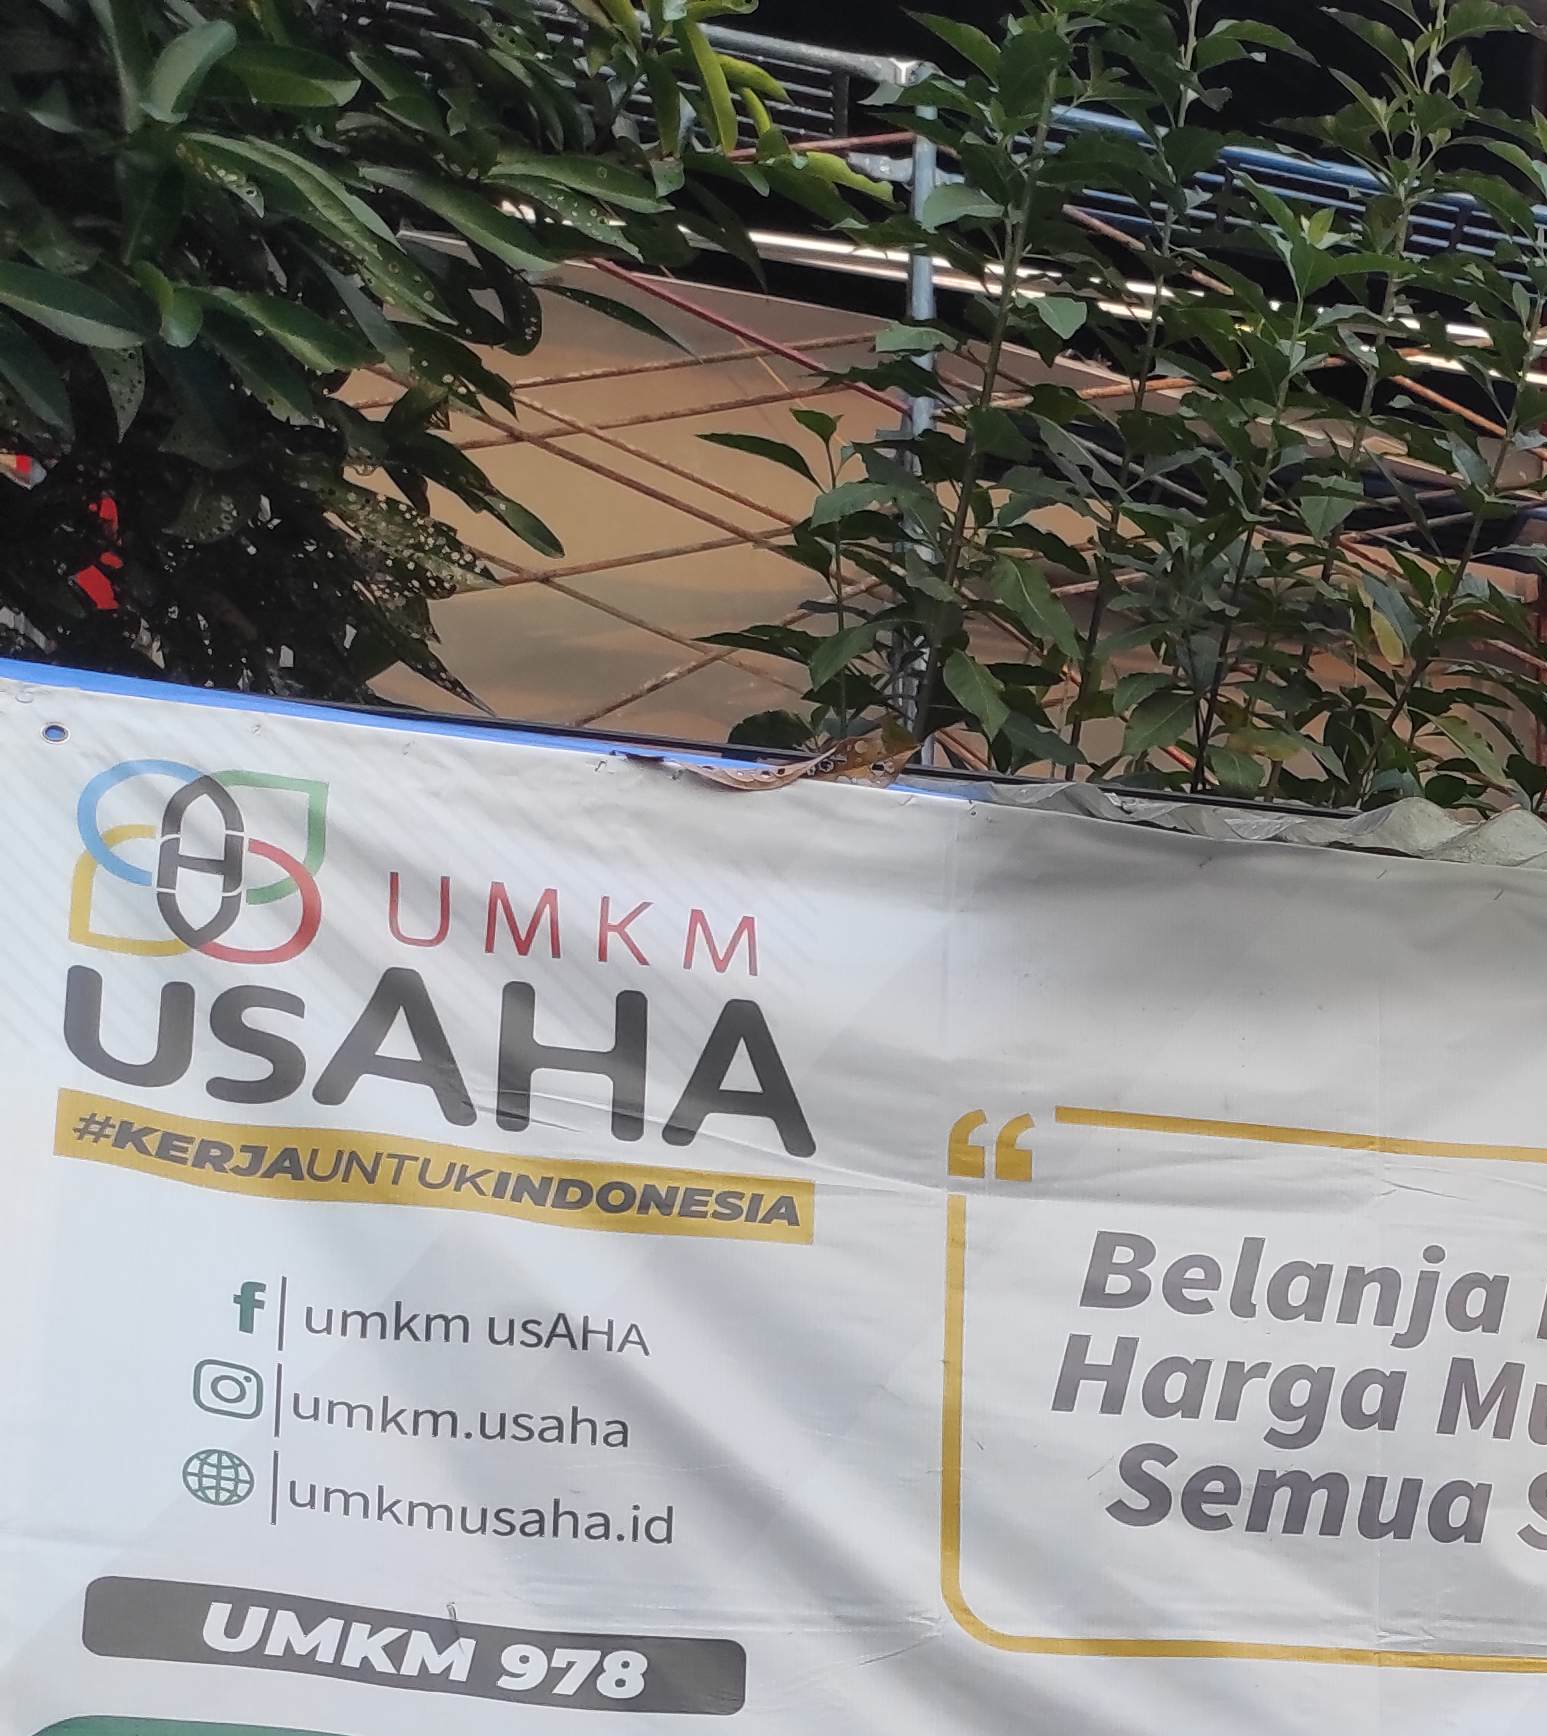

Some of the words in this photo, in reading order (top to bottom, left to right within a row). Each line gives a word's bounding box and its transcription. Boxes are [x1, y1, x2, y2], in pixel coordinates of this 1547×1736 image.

[388, 871, 760, 977] UMKM
[72, 1111, 802, 1228] #KERJAUNTUKINDONESIA
[303, 1299, 471, 1345] umkm
[486, 1308, 652, 1358] usAHA
[1077, 1229, 1511, 1350] Belanja
[289, 1385, 631, 1449] umkm.usaha
[1050, 1331, 1408, 1451] Harga
[287, 1471, 675, 1546] umkmusaha.id
[1104, 1441, 1494, 1545] Semua
[200, 1600, 478, 1683] UMKM
[496, 1642, 647, 1701] 978
